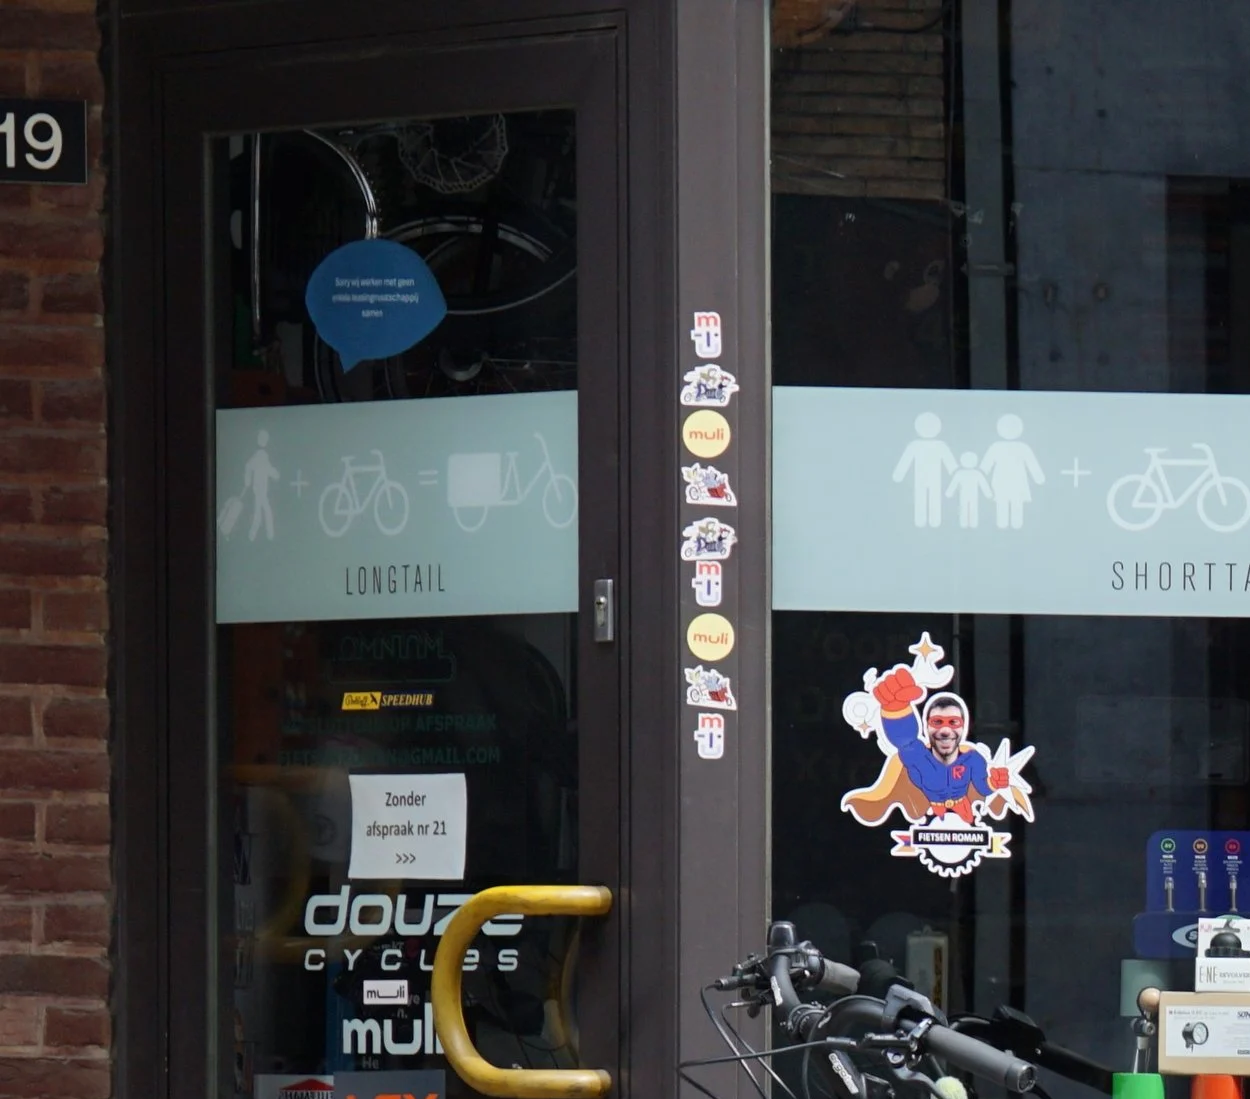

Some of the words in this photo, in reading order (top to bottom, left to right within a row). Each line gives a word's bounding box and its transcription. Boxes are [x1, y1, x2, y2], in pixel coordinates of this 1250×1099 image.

[0, 112, 63, 171] 19
[689, 427, 725, 441] muli
[345, 563, 446, 596] LONGTAIL
[692, 630, 729, 645] muli
[381, 693, 433, 707] SPEEDHUB
[385, 791, 427, 807] Zonder
[366, 821, 415, 839] afspraak
[417, 823, 430, 837] nr
[432, 820, 448, 837] 21
[918, 832, 951, 843] FIETSEN
[952, 832, 984, 843] ROMAN
[366, 985, 406, 999] muli
[342, 1002, 445, 1055] mul
